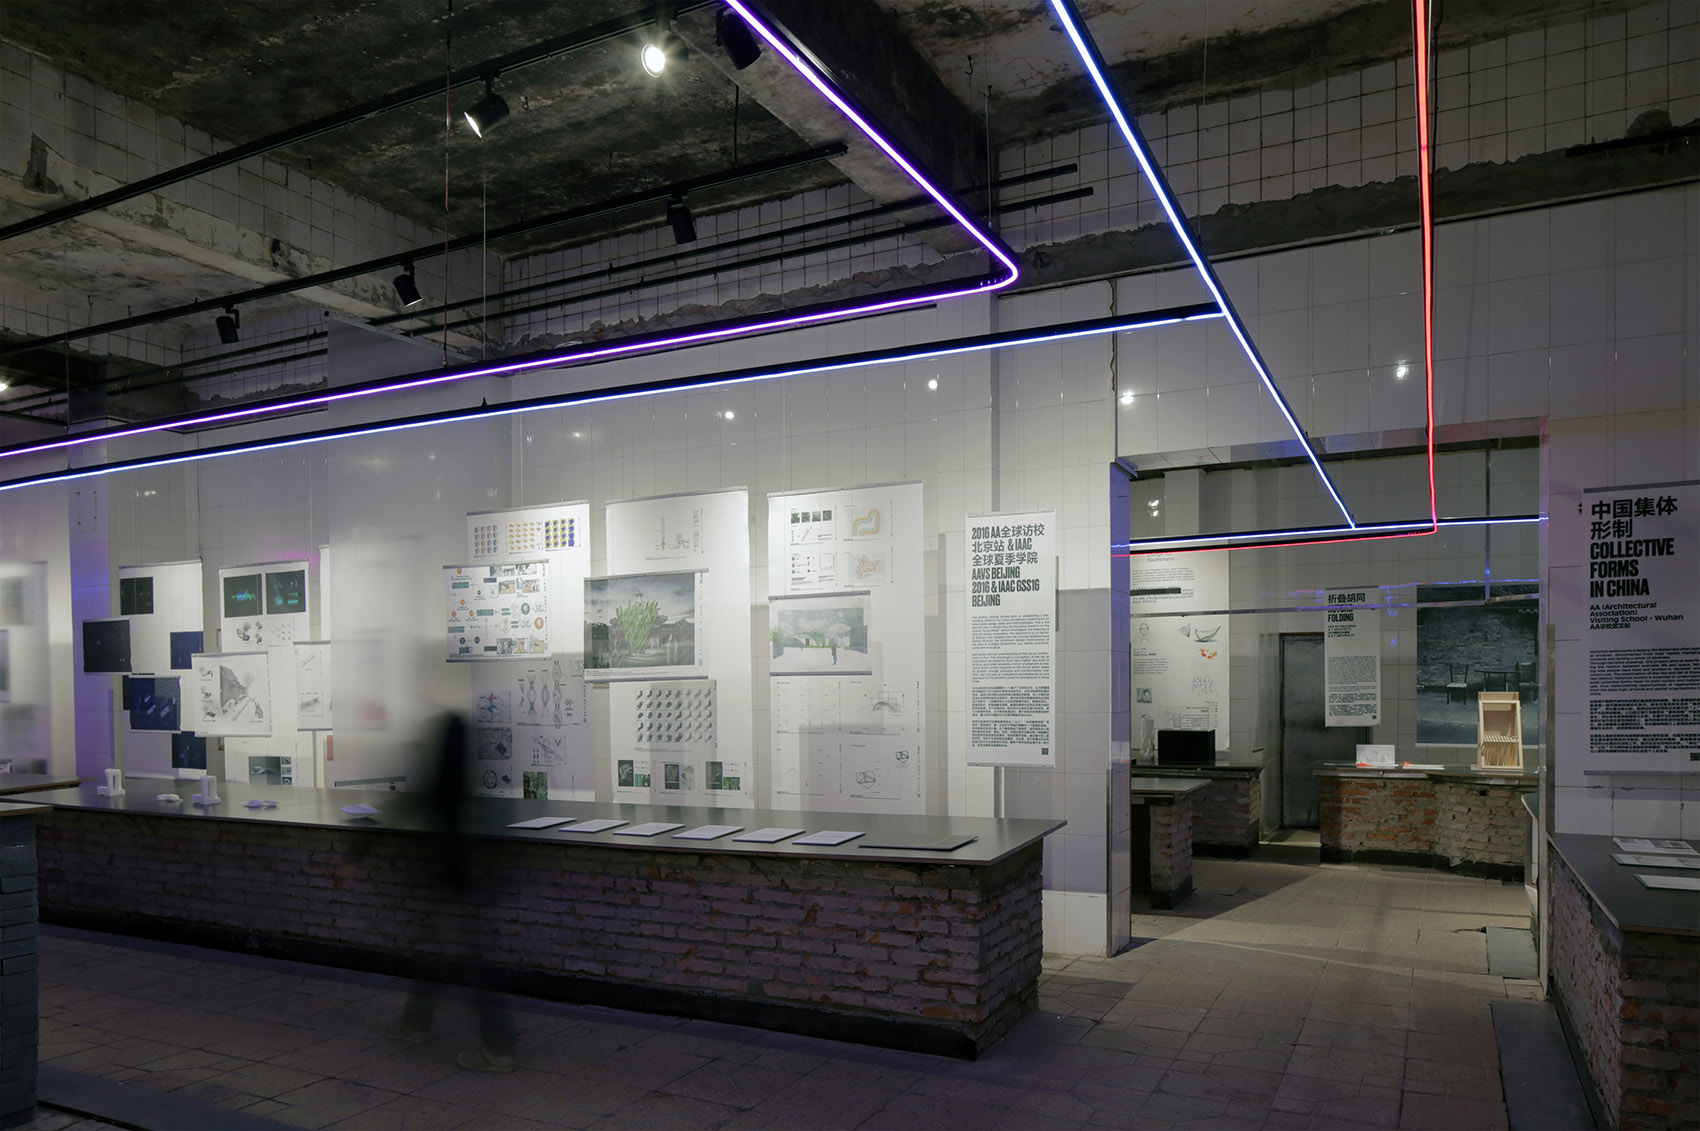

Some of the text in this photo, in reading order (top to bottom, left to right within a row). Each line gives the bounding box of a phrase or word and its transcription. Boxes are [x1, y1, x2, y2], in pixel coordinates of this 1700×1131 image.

[1591, 496, 1678, 520] 中国集体
[972, 526, 990, 540] 2016
[1590, 519, 1632, 540] 形制
[972, 538, 1032, 553] 北京站 & IAAC
[1590, 538, 1674, 559] COLLECTIVE
[972, 551, 1038, 566] 全球夏季学院
[972, 566, 1020, 580] AAVS BEIJING
[1590, 560, 1639, 578] FORMS
[972, 579, 1040, 594] 2016 & IAAC GSS16
[1590, 578, 1650, 598] IN CHINA
[972, 594, 1000, 607] BEIJING
[1328, 593, 1365, 603] 折叠胡同
[1328, 613, 1354, 622] FOLDING
